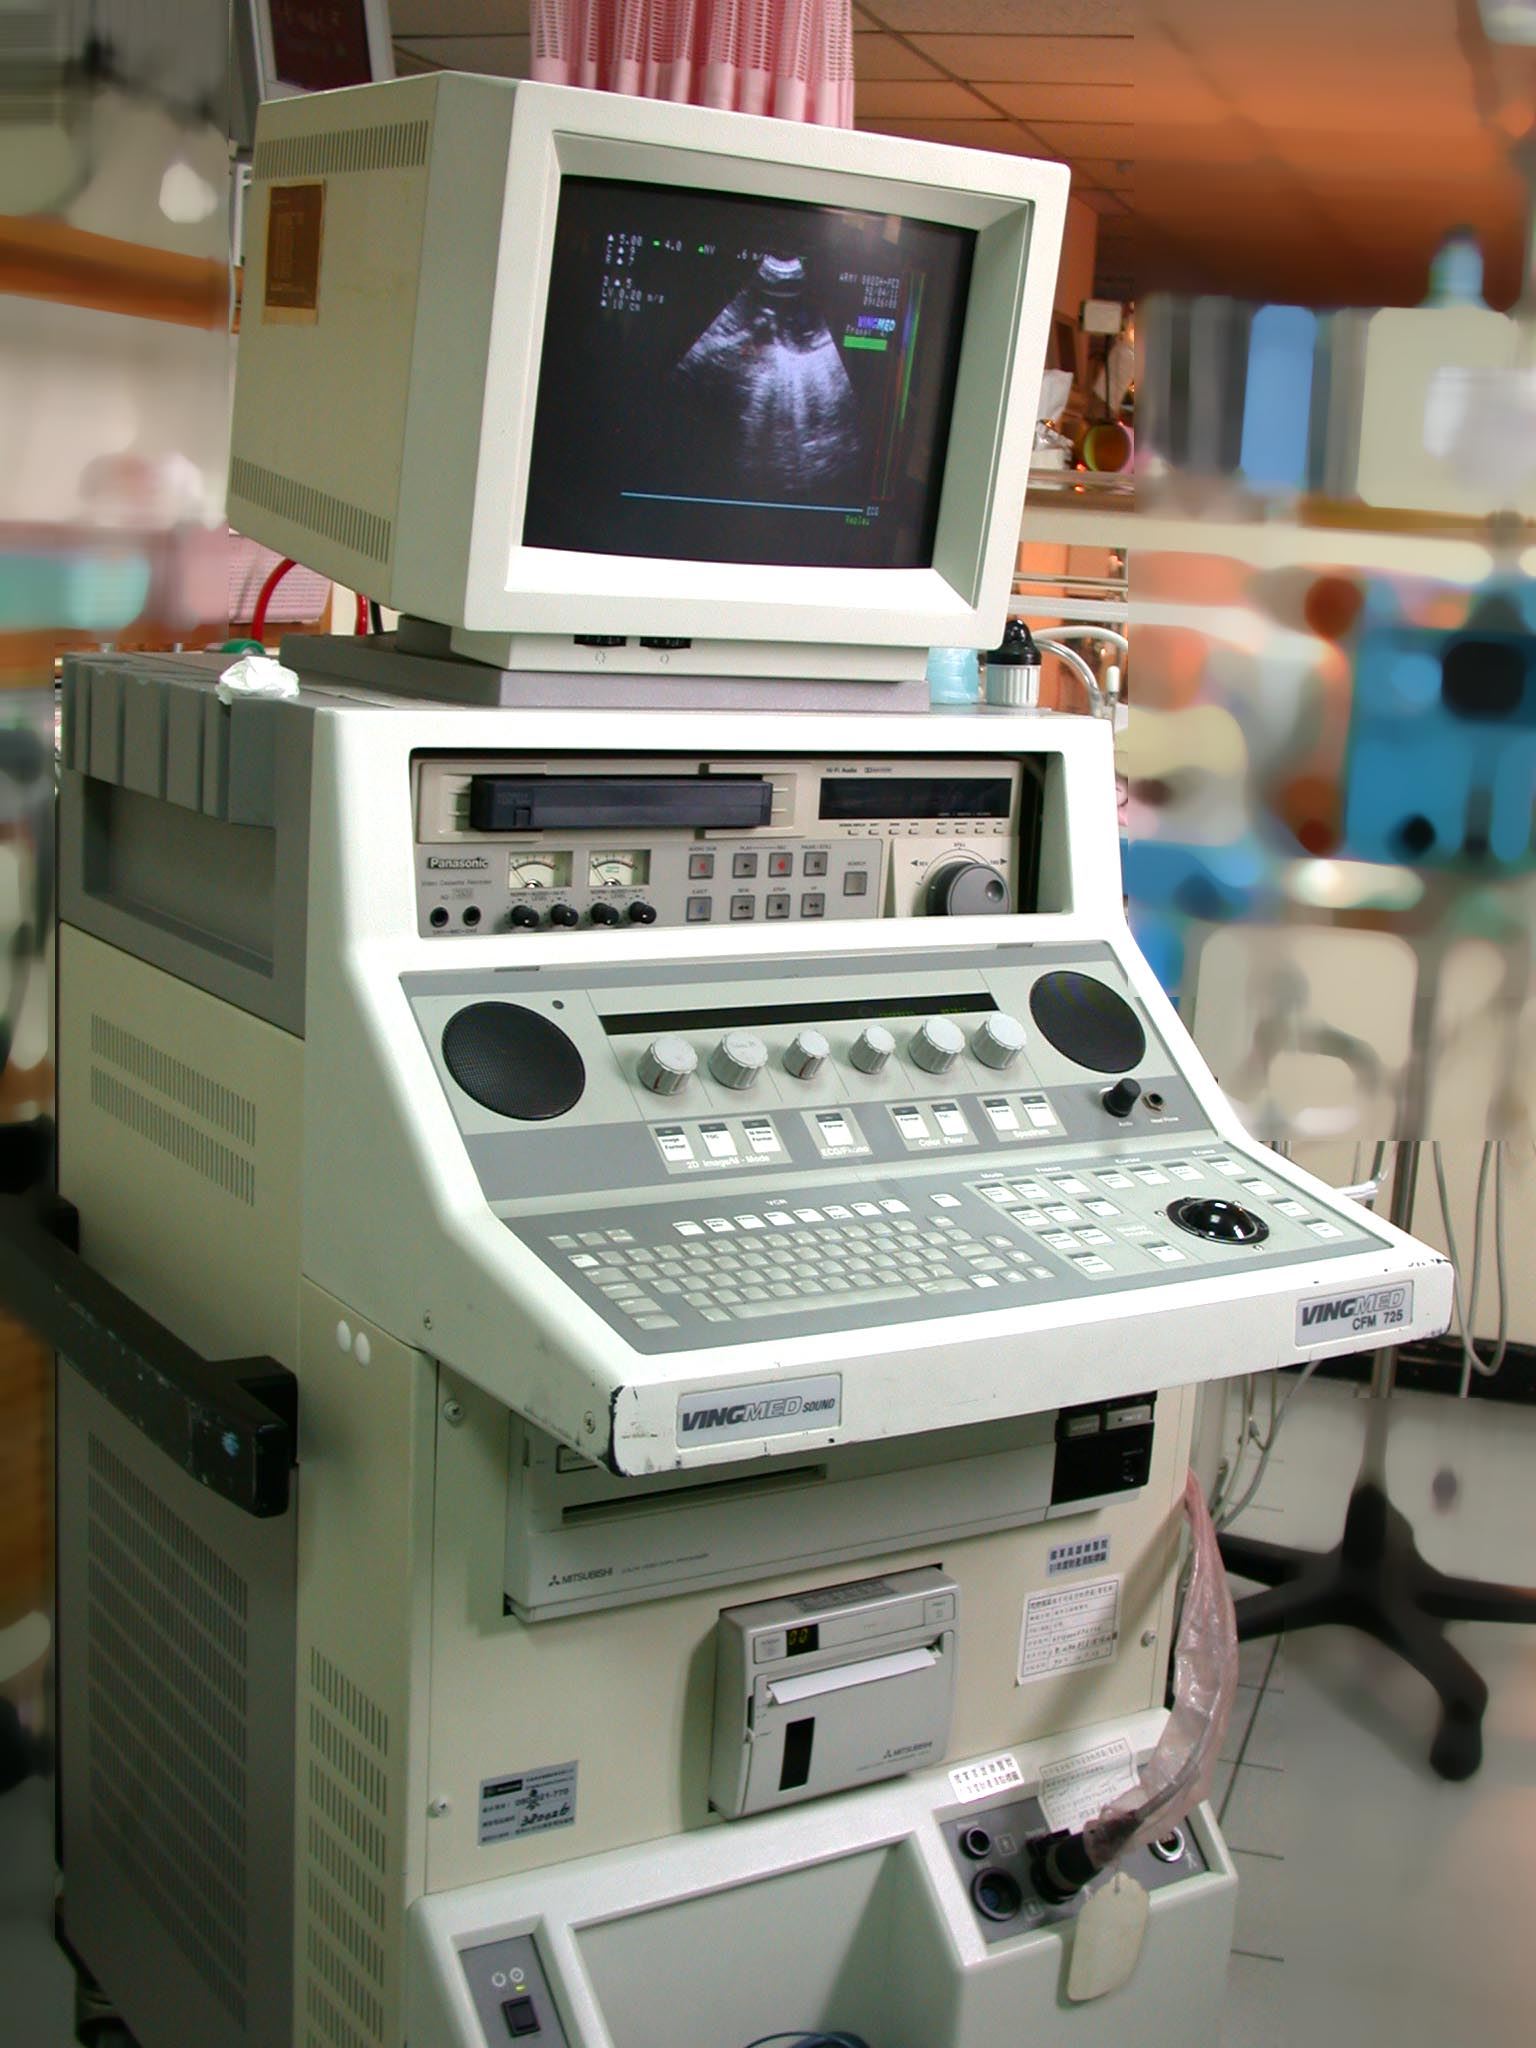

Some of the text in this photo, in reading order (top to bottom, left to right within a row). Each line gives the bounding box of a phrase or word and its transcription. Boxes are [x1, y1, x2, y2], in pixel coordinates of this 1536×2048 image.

[427, 857, 489, 870] Panasonic
[1302, 1288, 1405, 1326] VINGMED
[1352, 1309, 1403, 1330] CFM 725
[682, 1396, 835, 1431] VINGMED SOUND
[562, 1567, 613, 1585] MITSUBISHI
